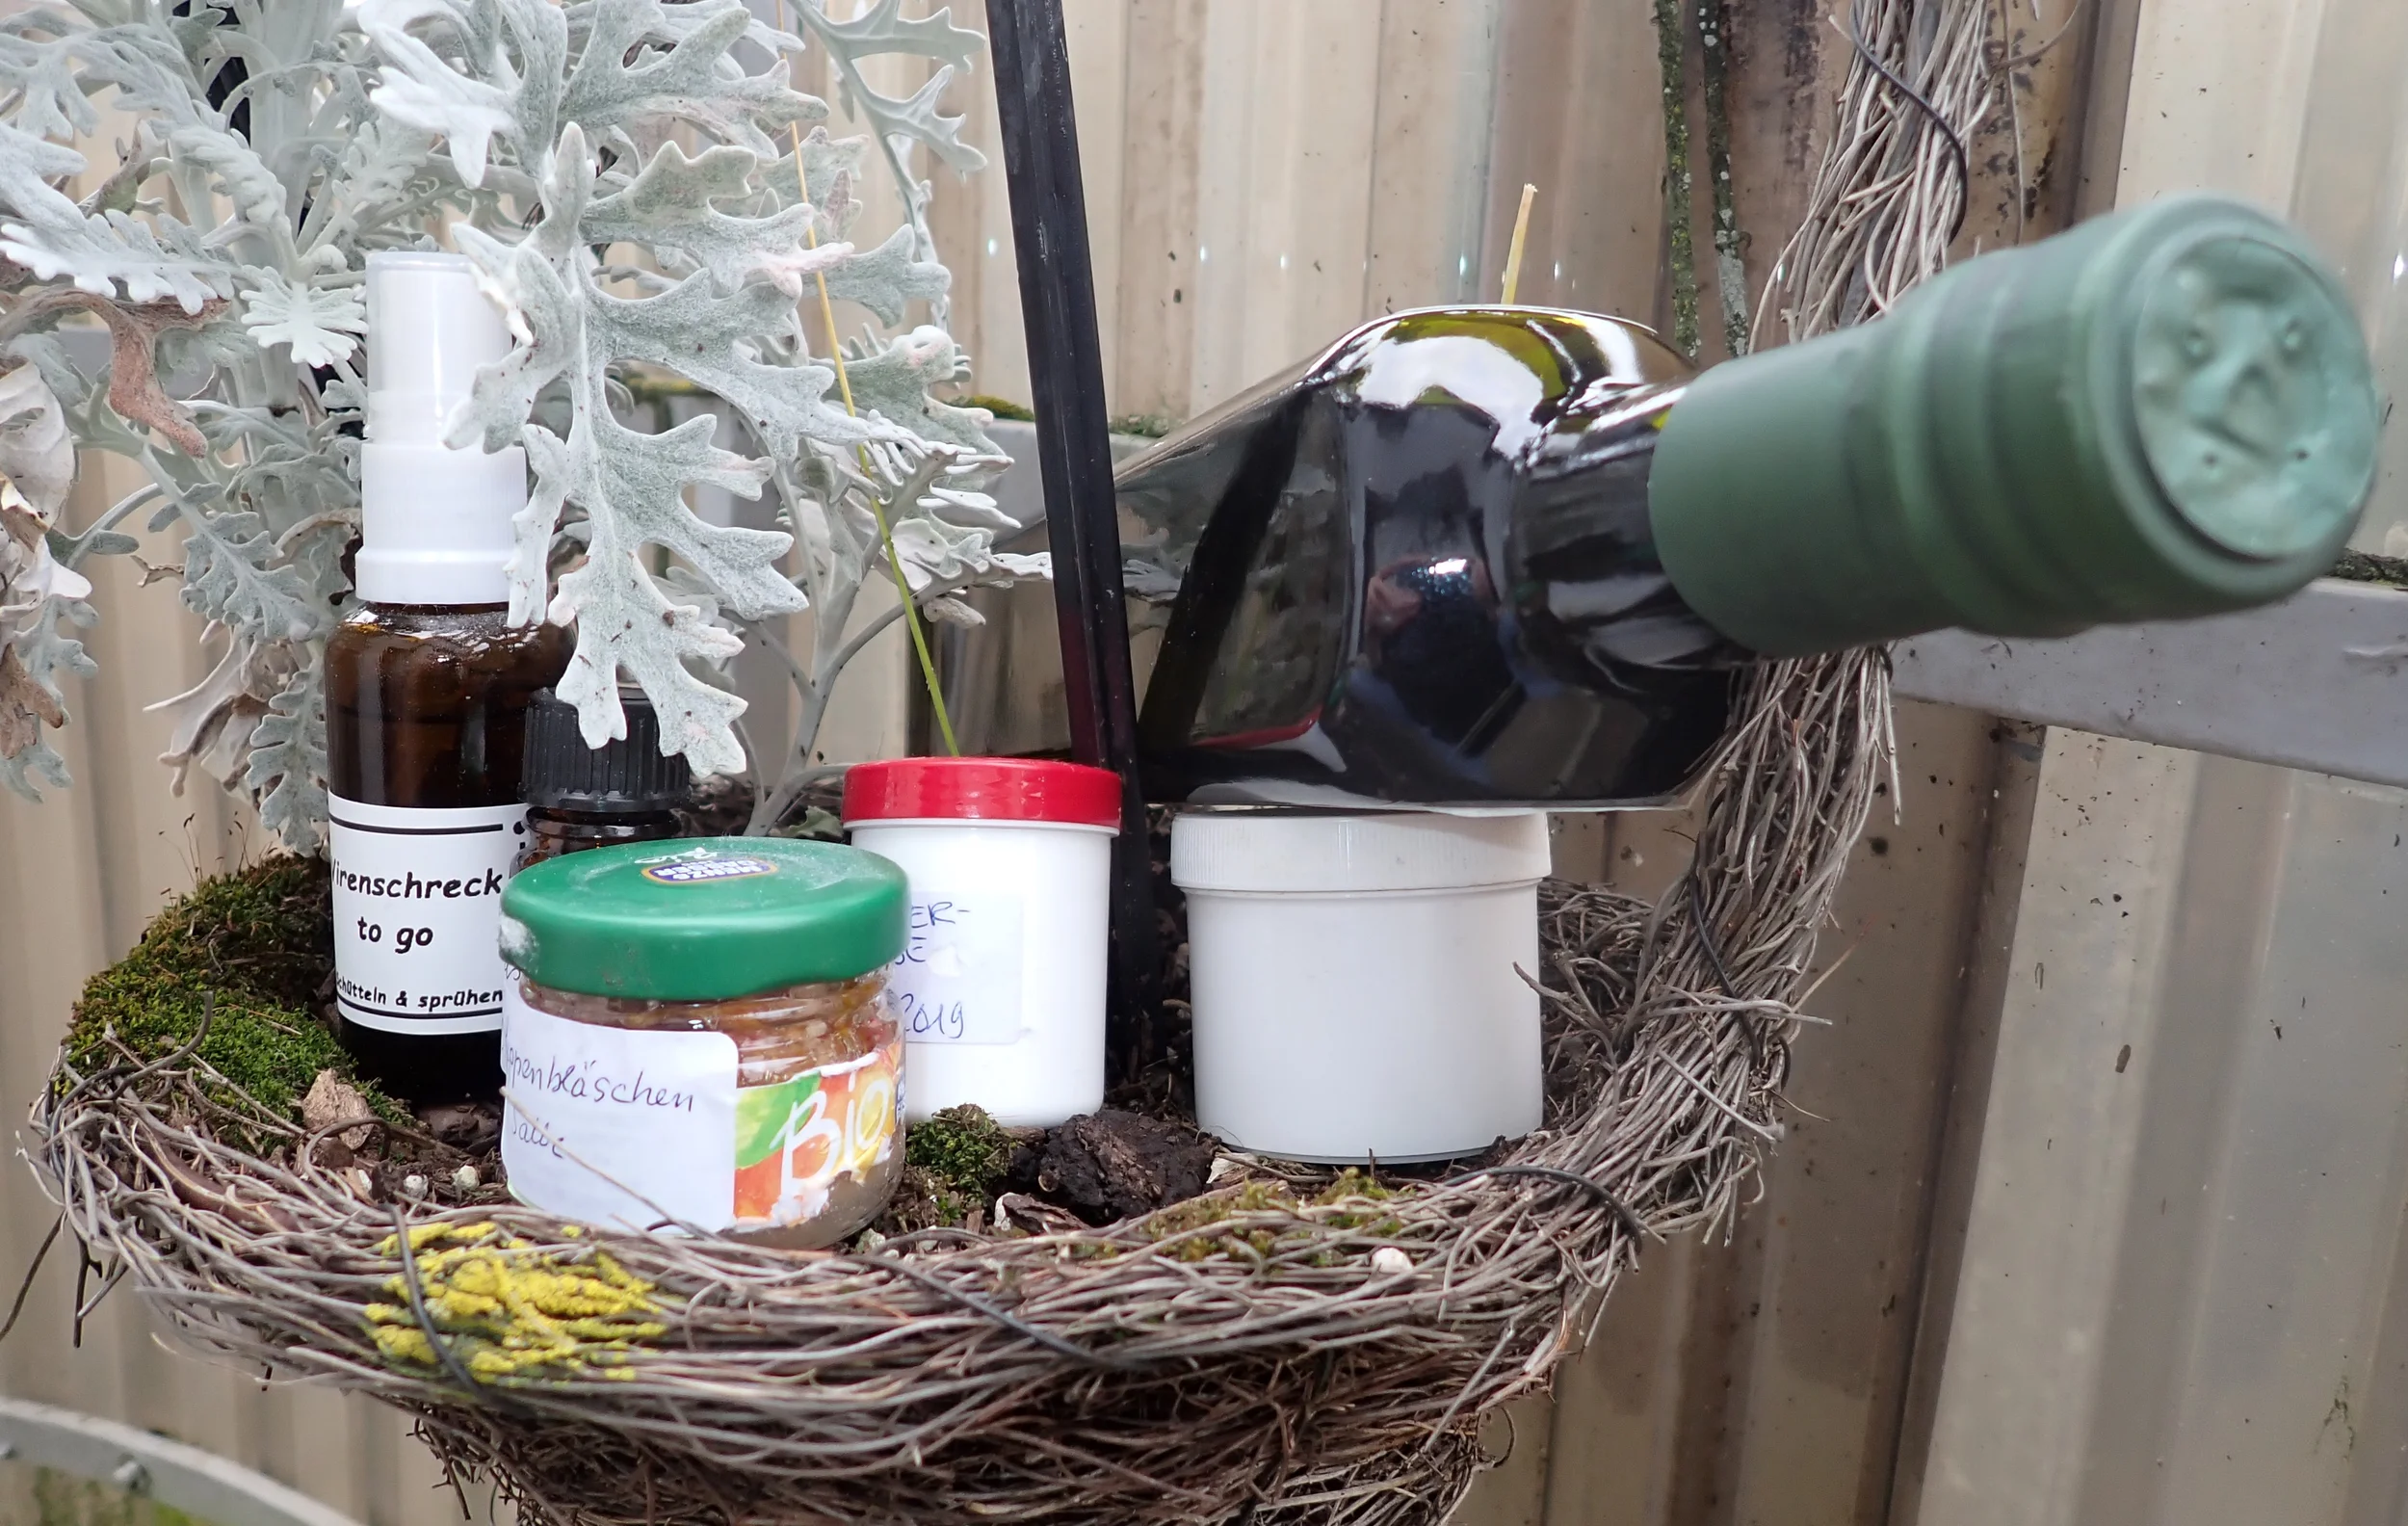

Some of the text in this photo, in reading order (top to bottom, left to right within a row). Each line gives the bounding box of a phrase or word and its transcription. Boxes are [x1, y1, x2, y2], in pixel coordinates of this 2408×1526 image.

[357, 916, 433, 954] to go
[336, 972, 503, 1012] chütteln & sprühen
